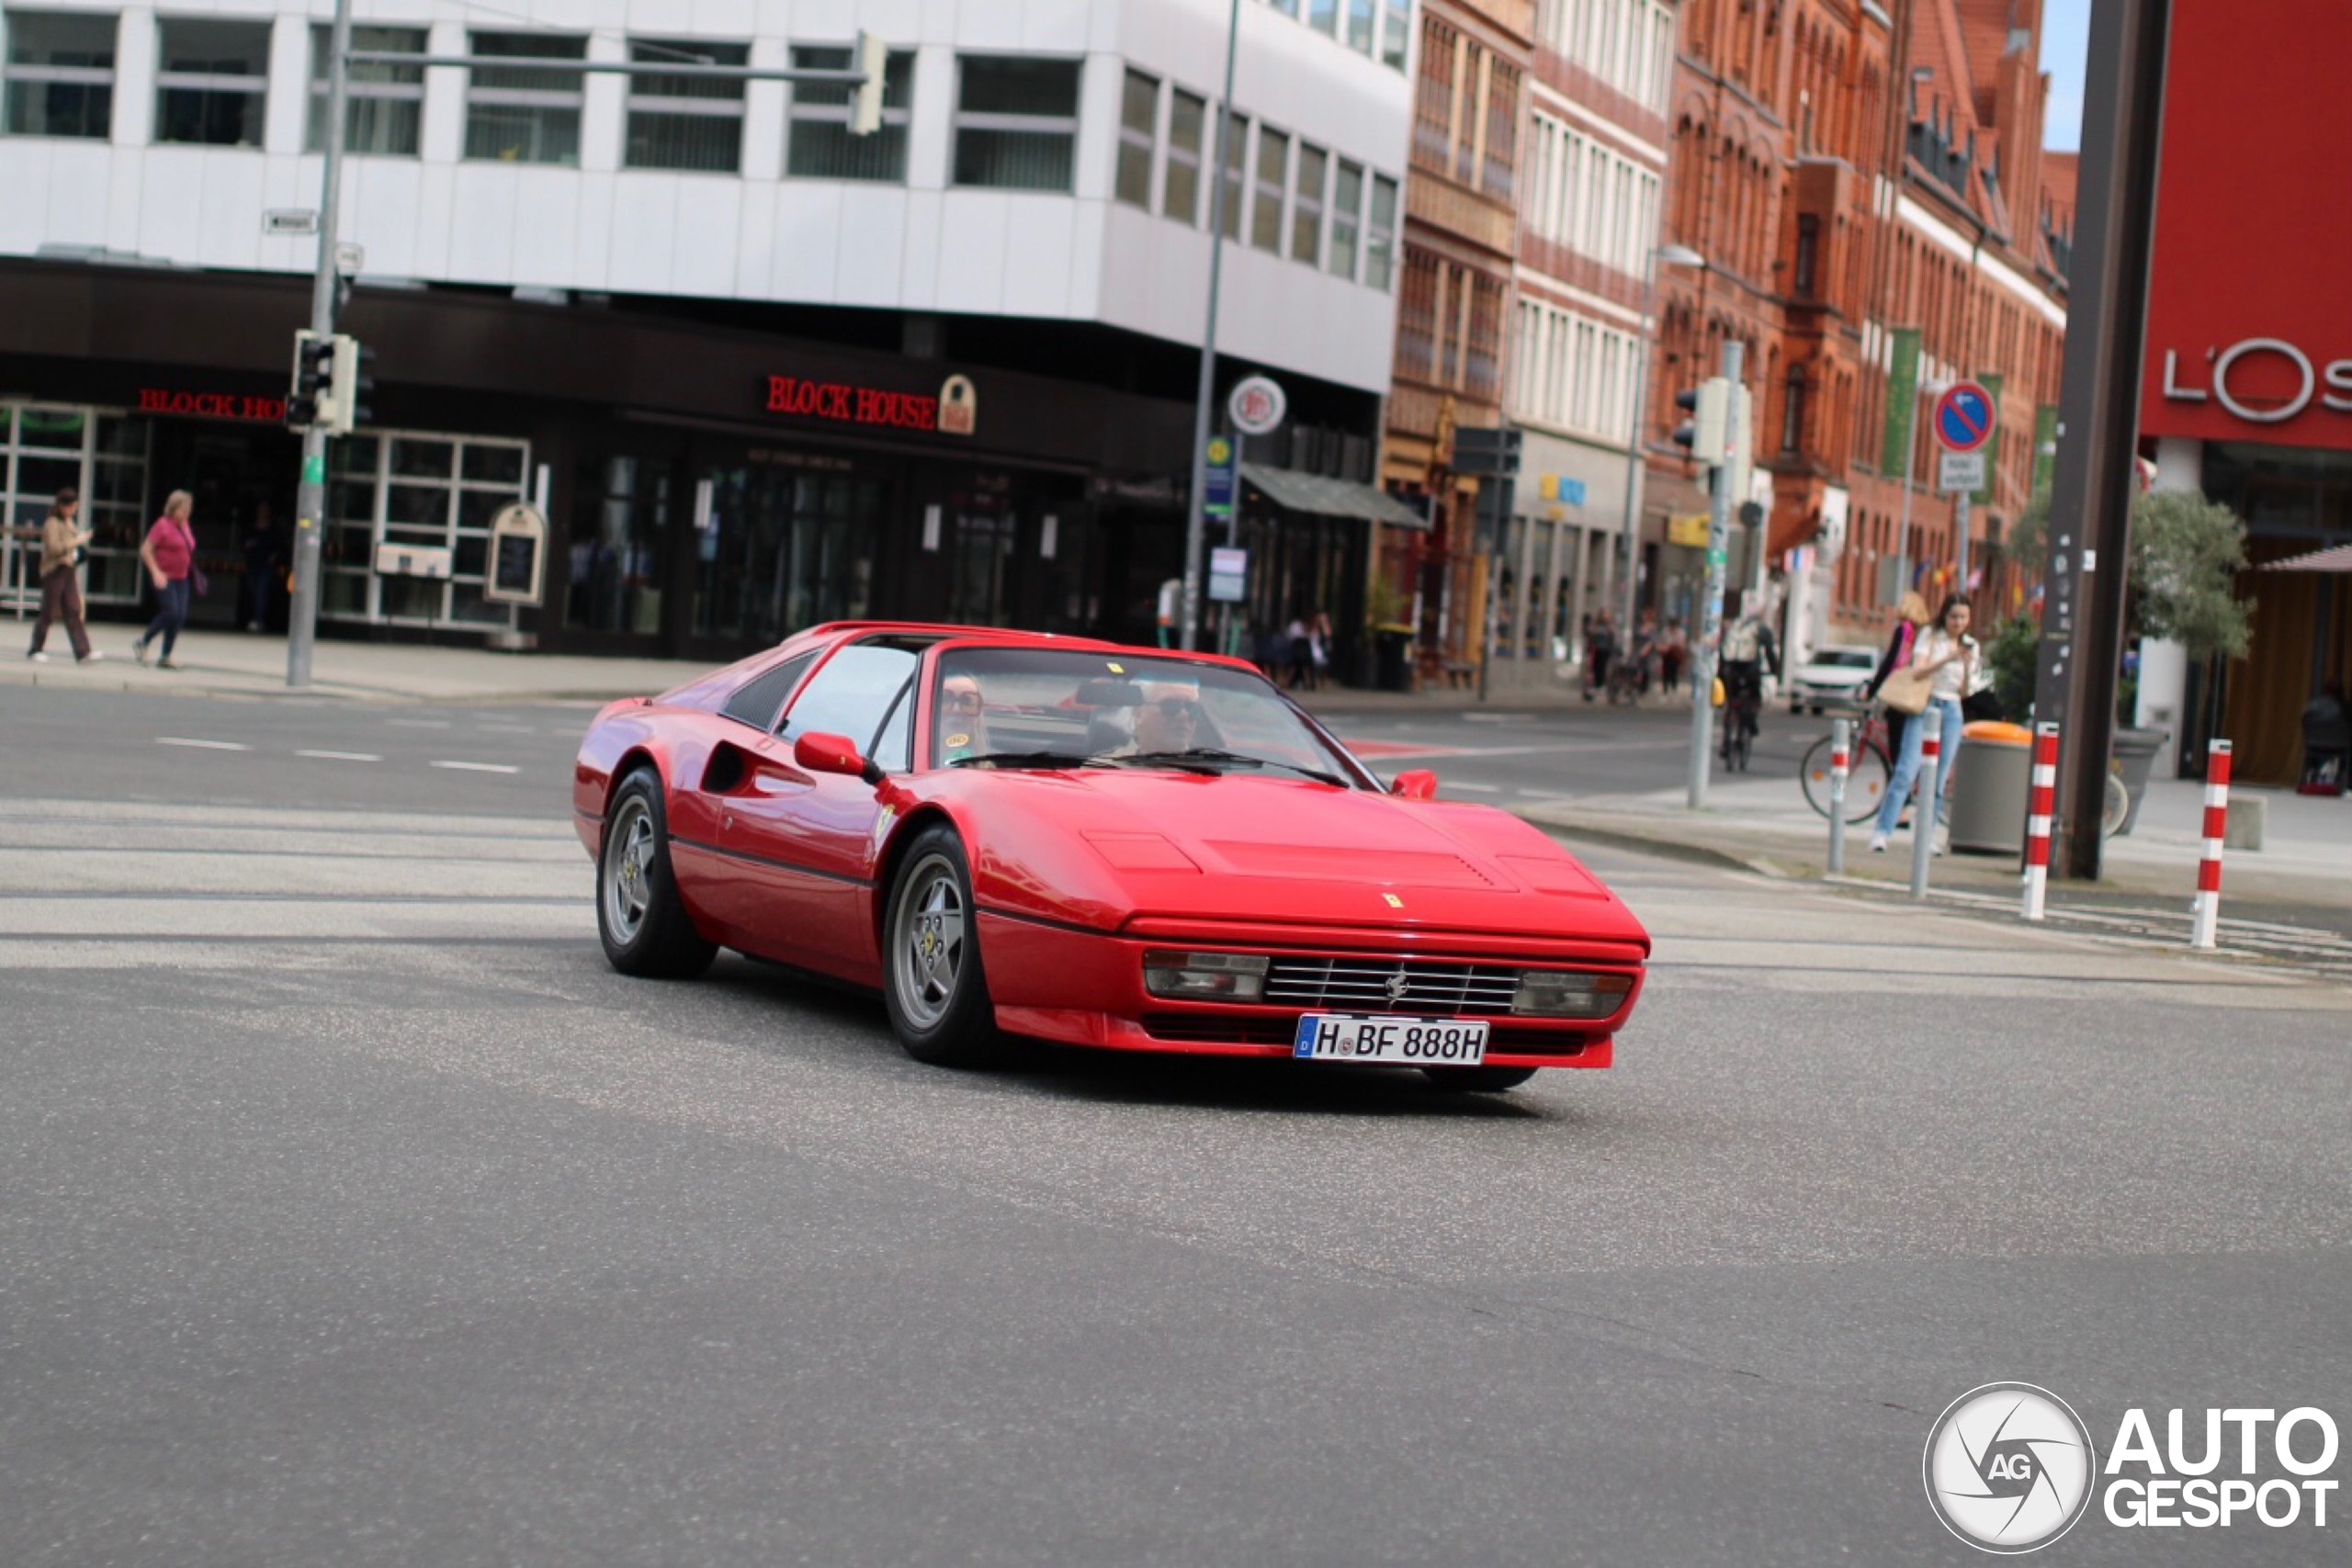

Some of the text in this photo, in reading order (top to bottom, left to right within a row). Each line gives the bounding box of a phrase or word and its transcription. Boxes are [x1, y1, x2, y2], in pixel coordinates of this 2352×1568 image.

[141, 389, 285, 420] BLOCK HO
[767, 375, 852, 419] BLOCK
[855, 388, 936, 429] HOUSE
[1316, 1023, 1483, 1059] H BF 888H
